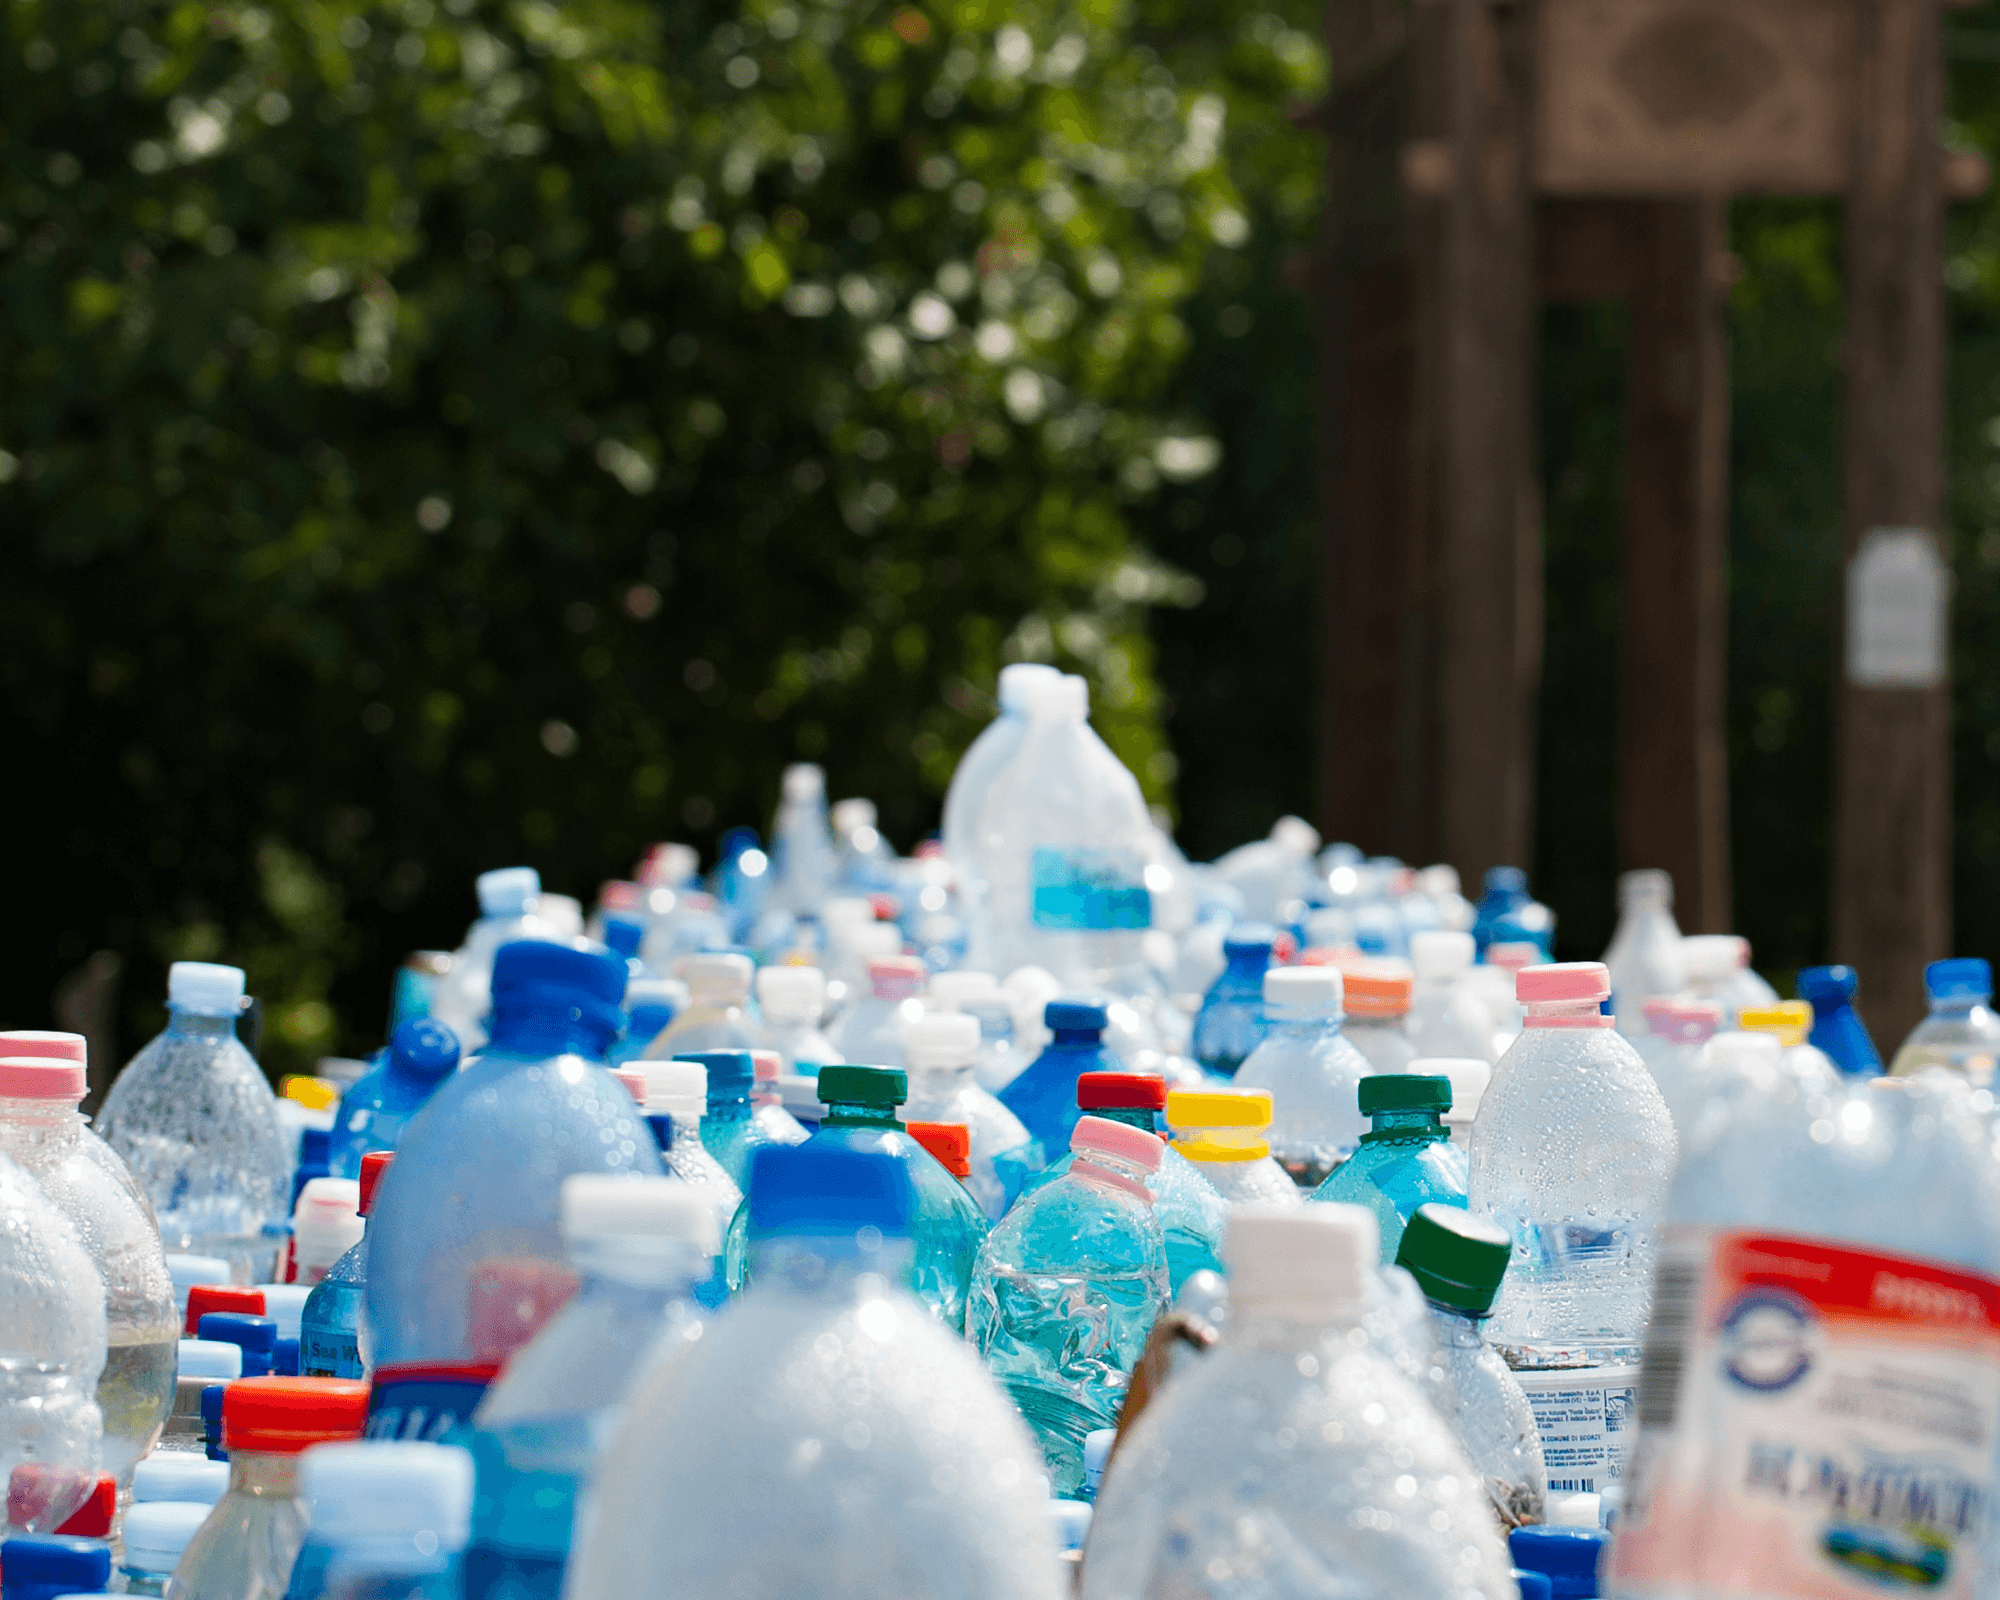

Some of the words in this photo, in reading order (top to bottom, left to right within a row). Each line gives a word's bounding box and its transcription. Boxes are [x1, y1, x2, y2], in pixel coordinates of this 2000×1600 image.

[312, 1342, 337, 1359] Sea
[1546, 1434, 1569, 1442] COMUNE
[1571, 1434, 1578, 1442] DI
